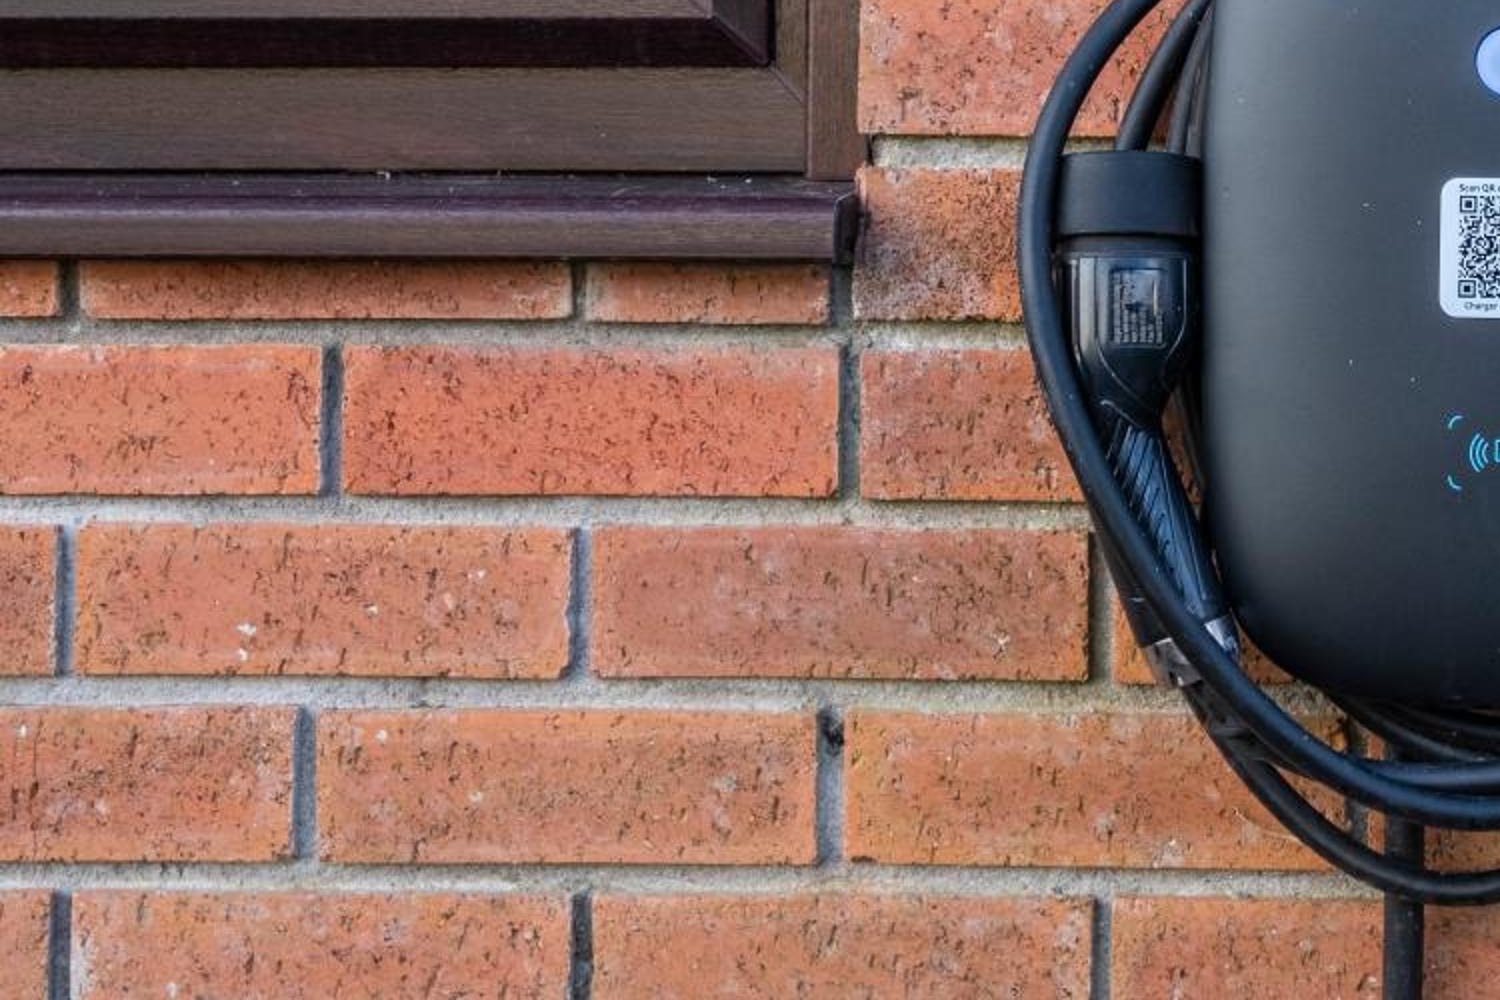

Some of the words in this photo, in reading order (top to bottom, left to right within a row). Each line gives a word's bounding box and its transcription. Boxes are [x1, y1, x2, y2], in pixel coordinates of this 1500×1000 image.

[1459, 184, 1480, 193] Scan
[1482, 184, 1494, 193] QR
[1464, 302, 1497, 311] Charger
